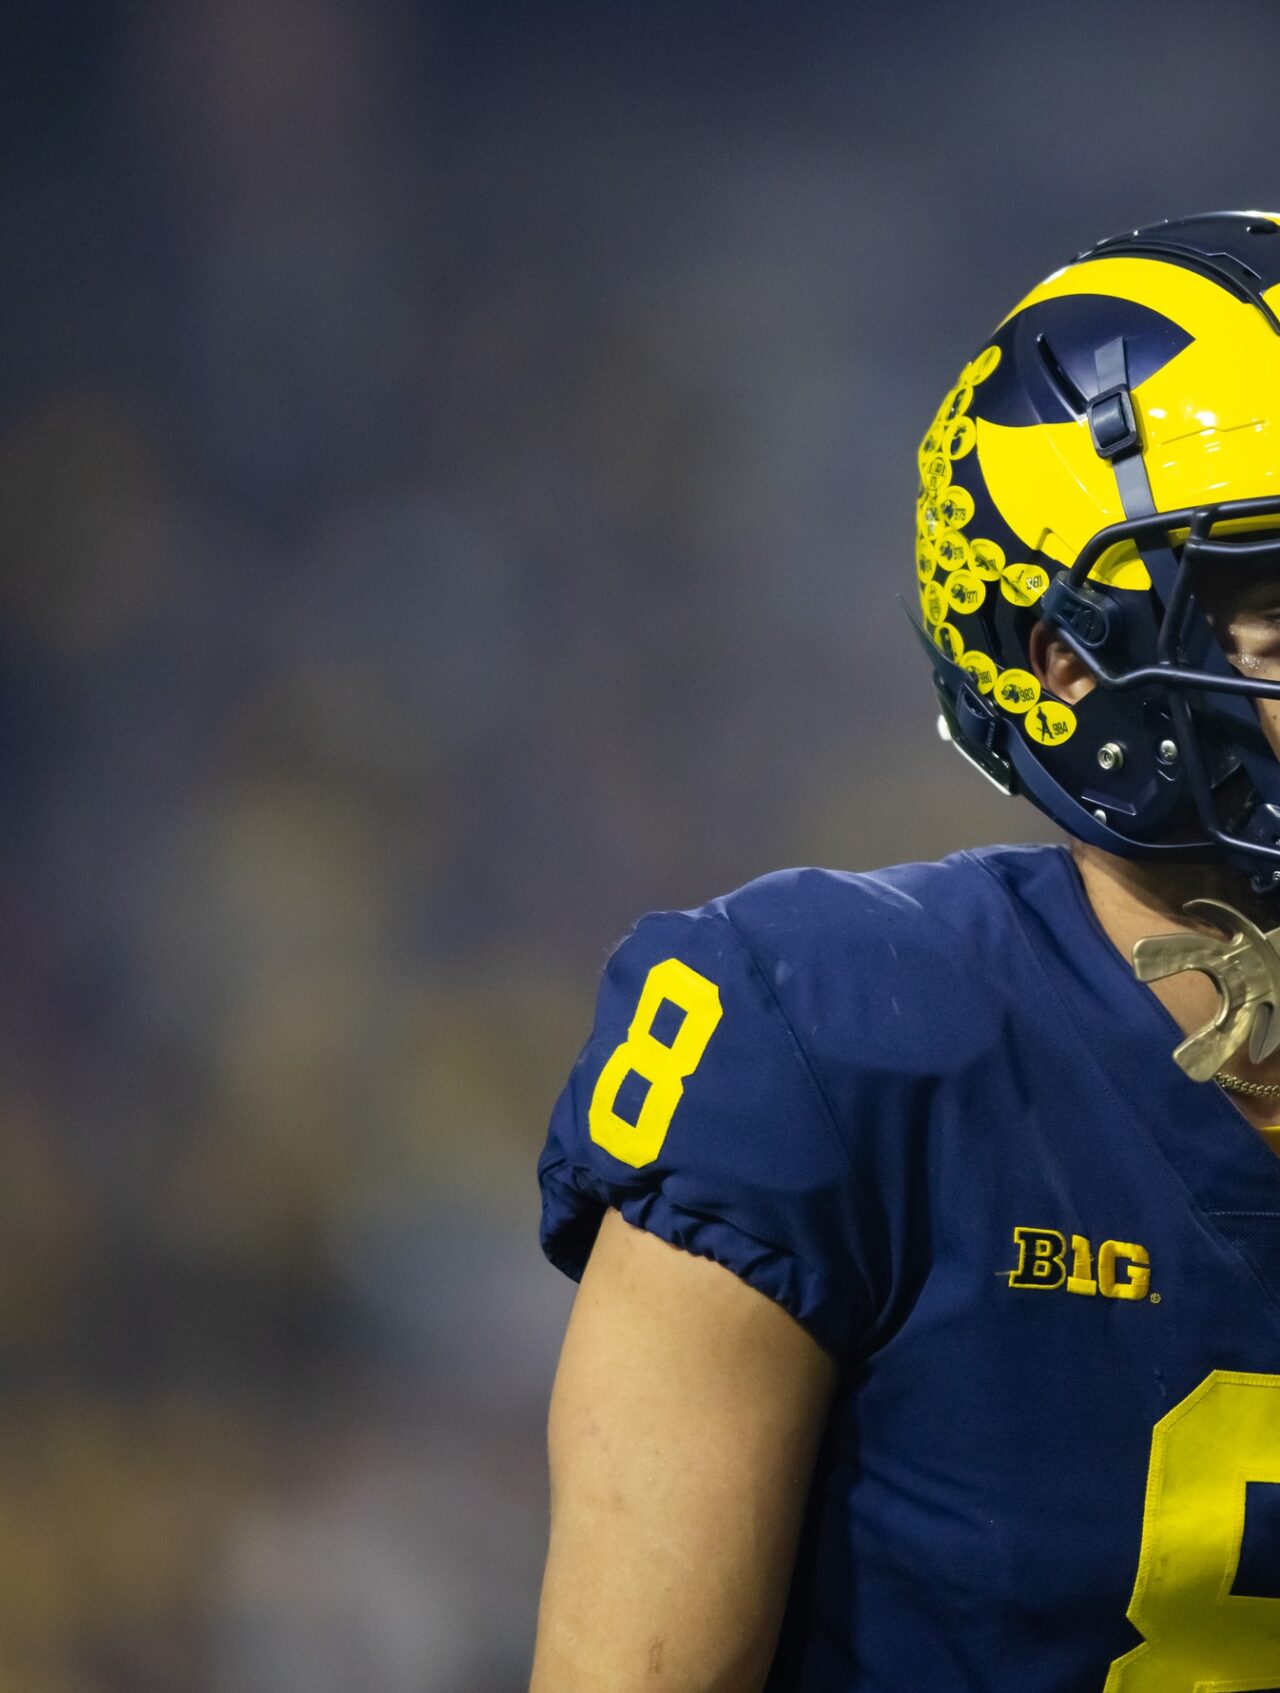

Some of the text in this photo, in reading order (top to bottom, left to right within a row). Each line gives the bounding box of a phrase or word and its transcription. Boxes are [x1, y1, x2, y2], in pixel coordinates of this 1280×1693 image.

[1020, 687, 1035, 703] 983
[1052, 721, 1069, 736] 984
[588, 957, 723, 1169] 8
